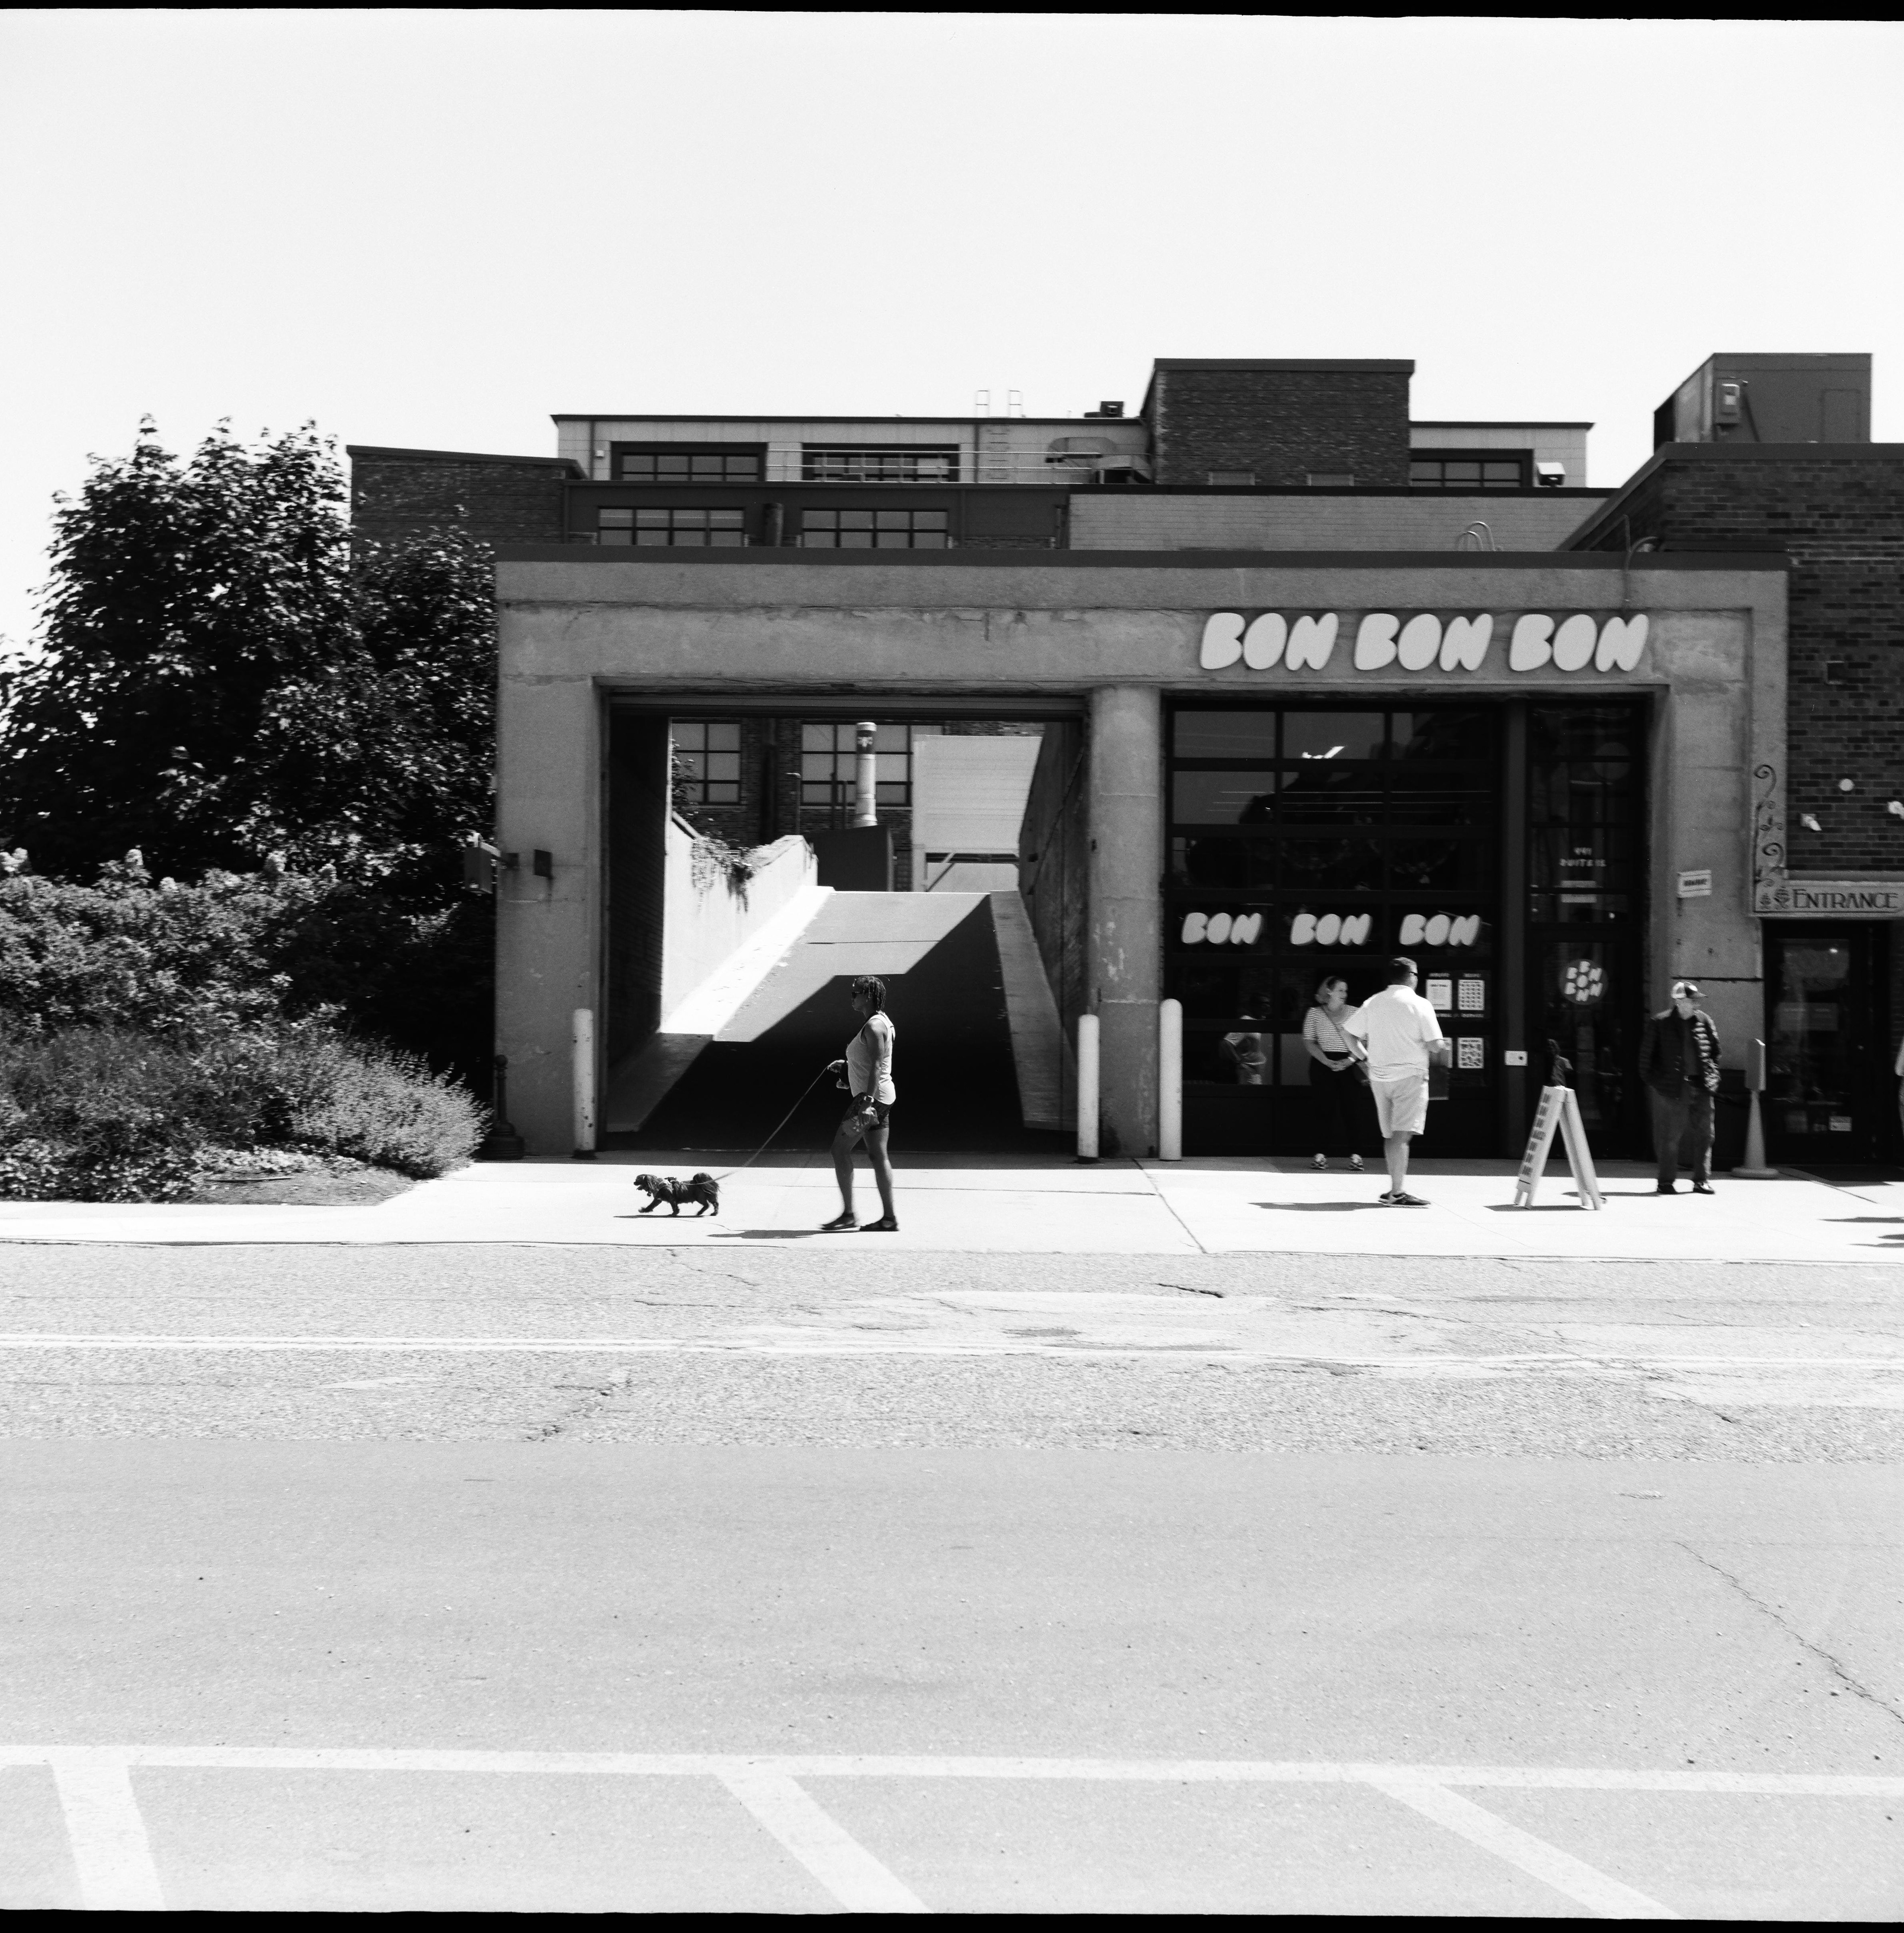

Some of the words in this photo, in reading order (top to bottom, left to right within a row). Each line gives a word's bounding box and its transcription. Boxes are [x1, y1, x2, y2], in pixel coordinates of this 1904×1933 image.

[1200, 612, 1338, 670] BON
[1355, 613, 1492, 671] BON
[1510, 614, 1649, 671] BON
[1559, 858, 1593, 867] SUITE
[1792, 889, 1898, 908] ENTRANCE
[1181, 912, 1263, 945] BON
[1290, 912, 1371, 946] BON
[1399, 913, 1481, 946] BON
